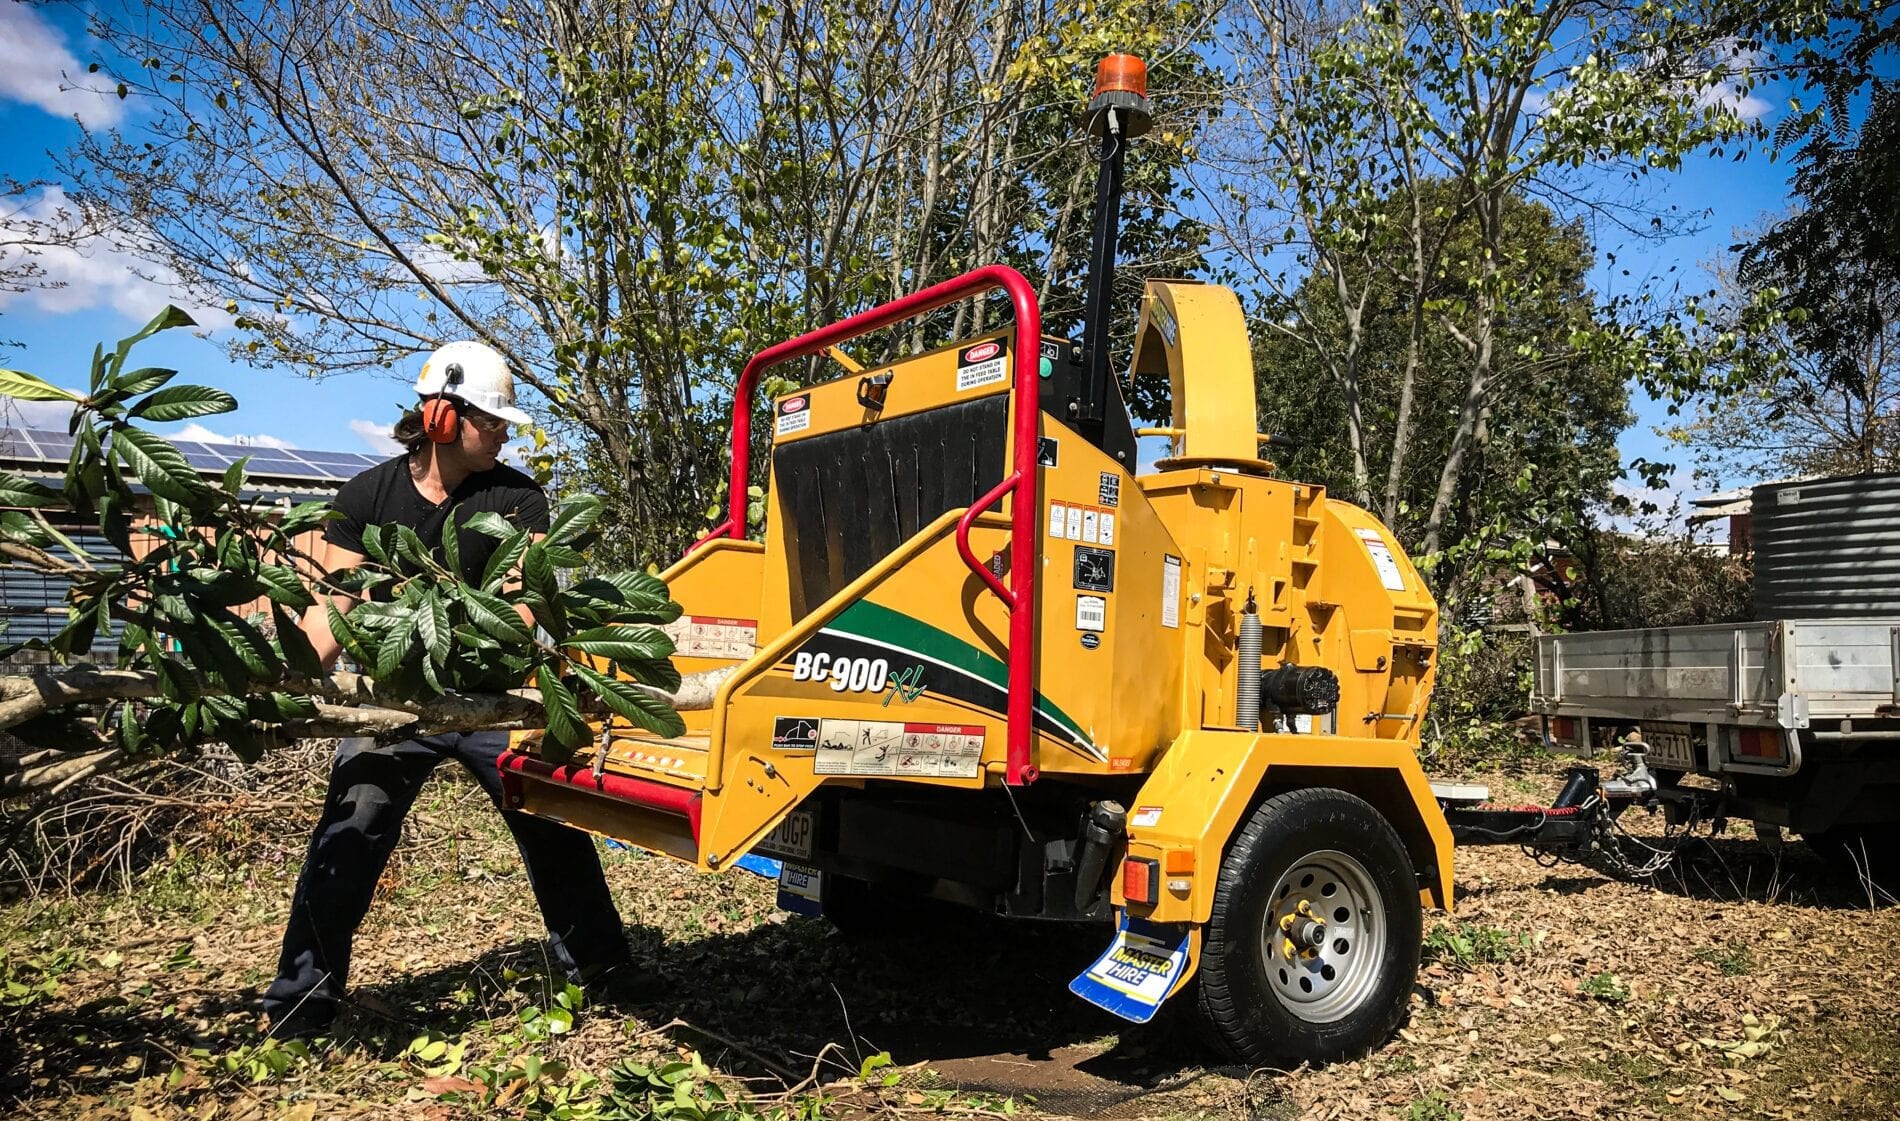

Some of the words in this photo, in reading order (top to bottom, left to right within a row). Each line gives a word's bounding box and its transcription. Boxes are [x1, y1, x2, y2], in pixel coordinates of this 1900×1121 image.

[970, 346, 995, 360] DANGER
[980, 362, 993, 370] STAND
[961, 379, 977, 387] DURING
[978, 373, 1001, 383] OPERATION
[882, 665, 927, 707] XL
[789, 871, 809, 888] HIRE
[1112, 947, 1172, 977] MASTER
[1108, 962, 1149, 985] HIRE
